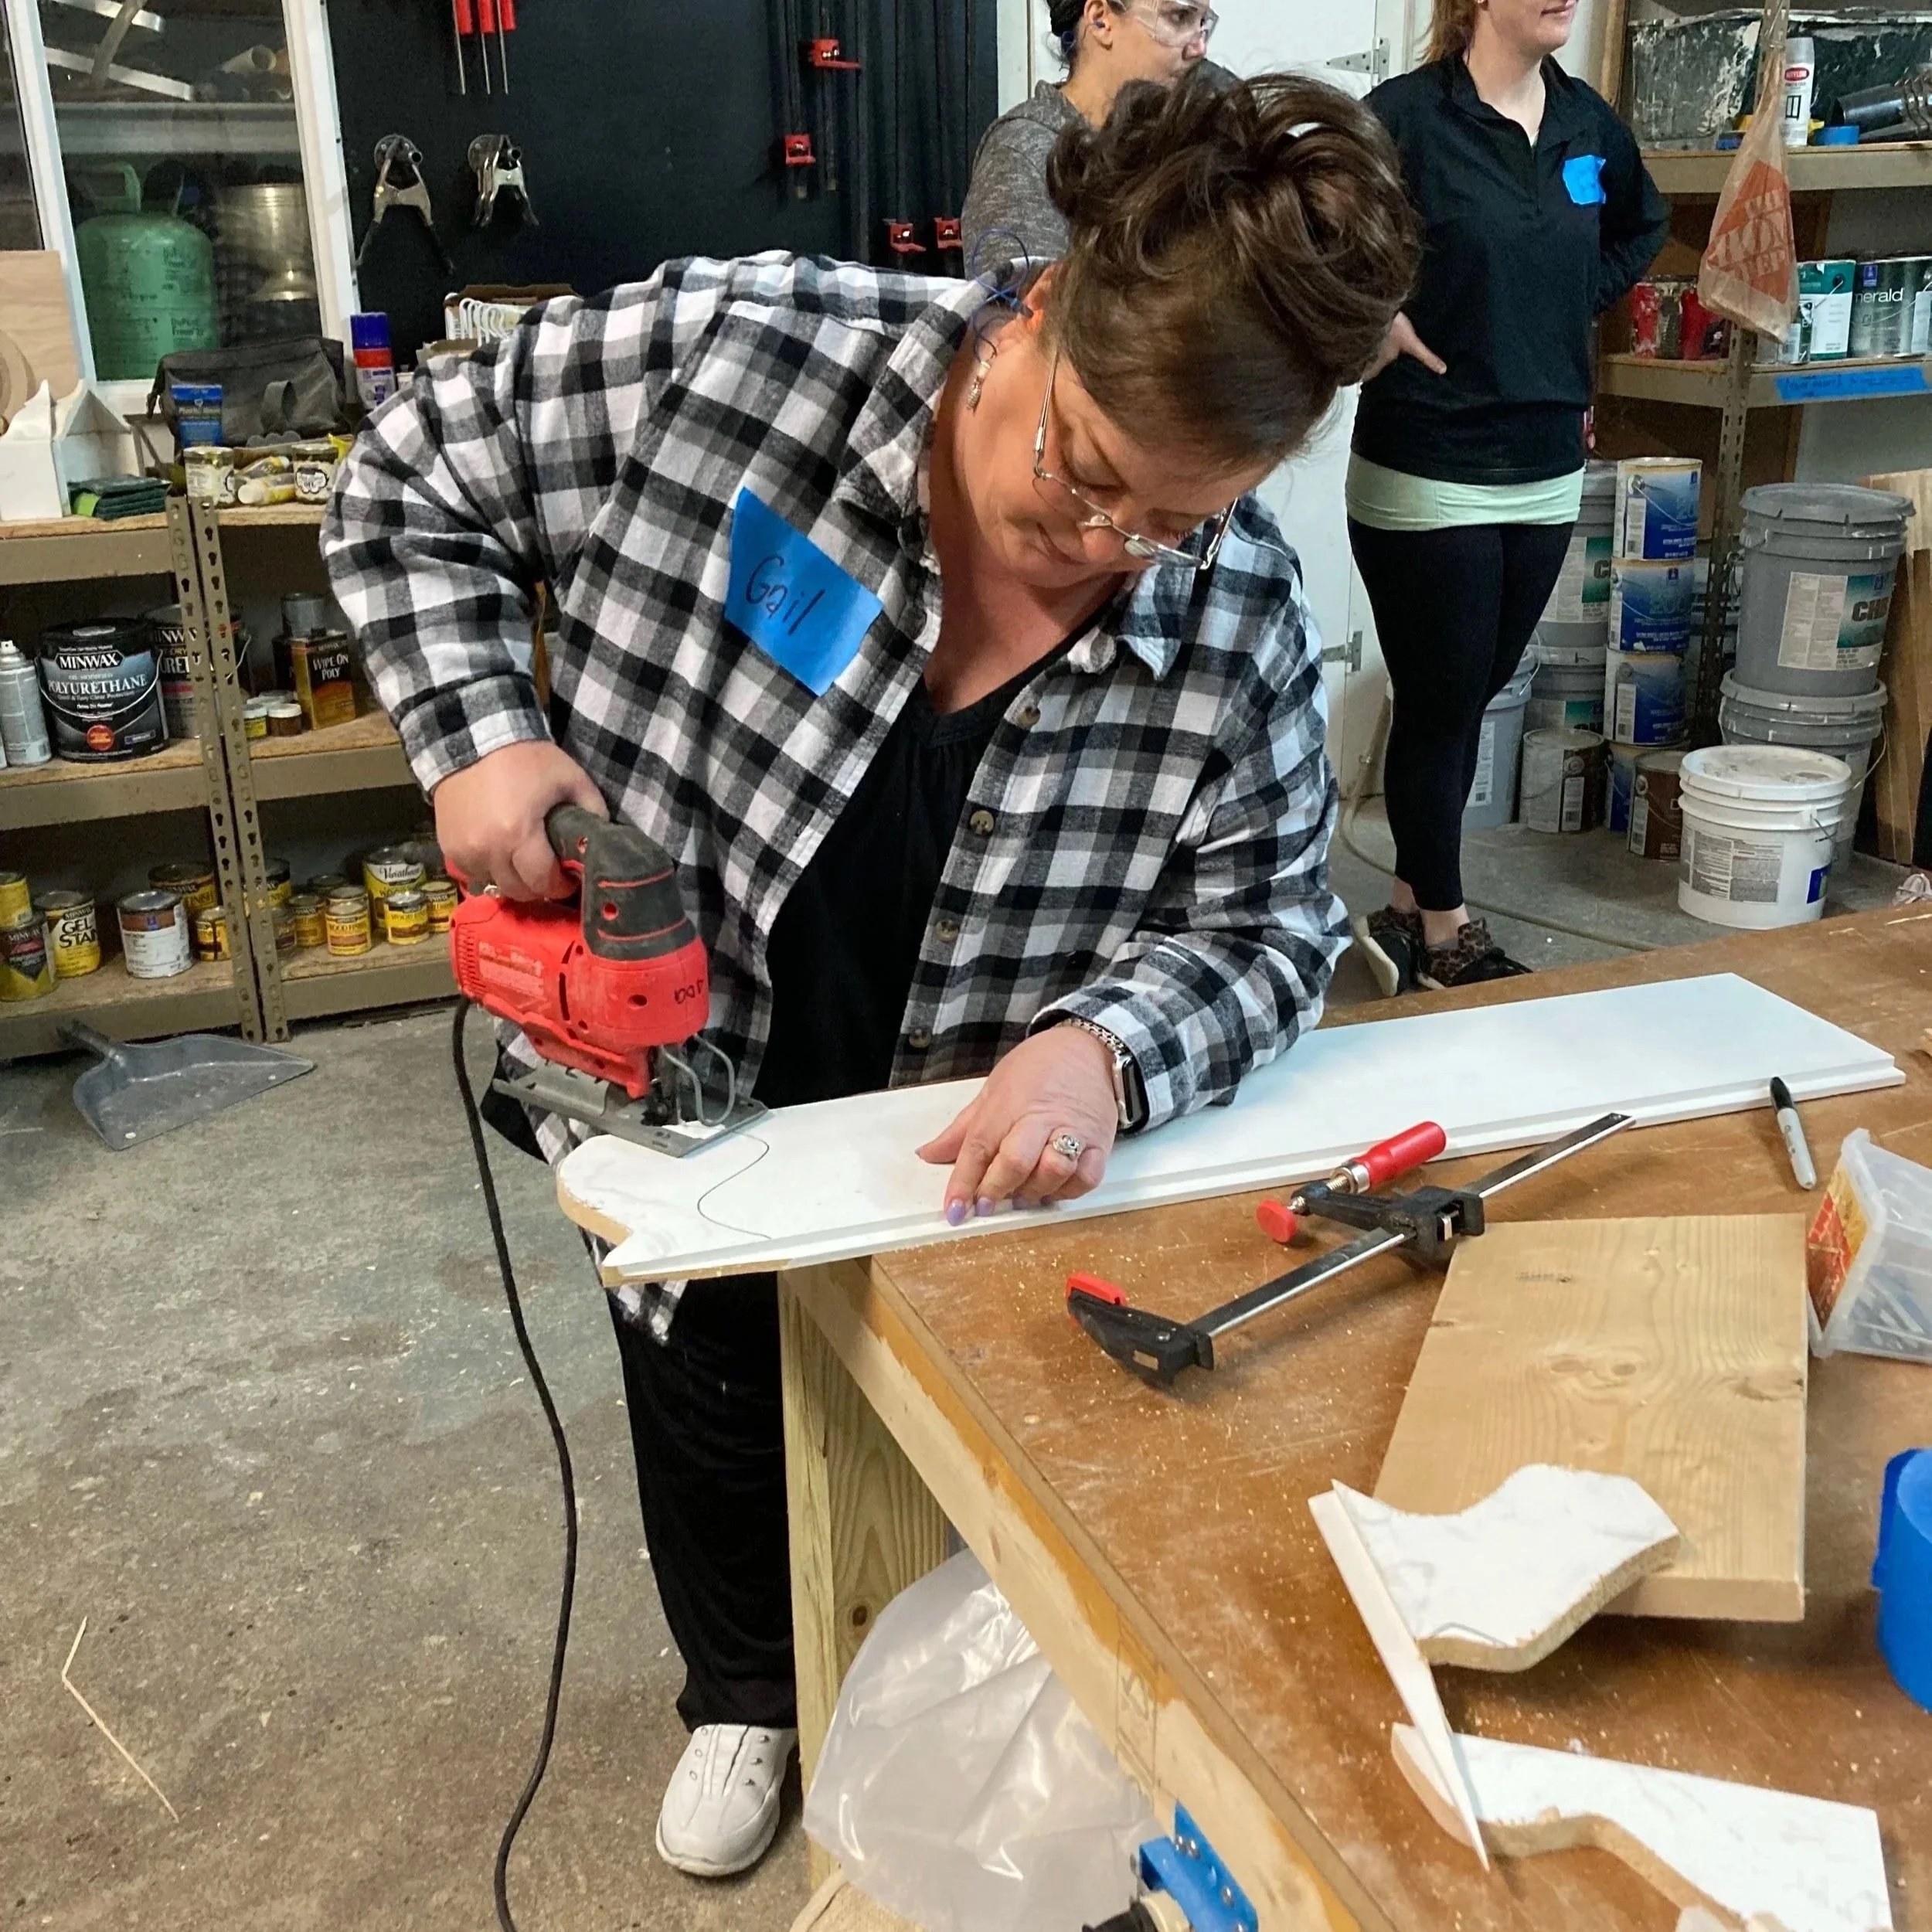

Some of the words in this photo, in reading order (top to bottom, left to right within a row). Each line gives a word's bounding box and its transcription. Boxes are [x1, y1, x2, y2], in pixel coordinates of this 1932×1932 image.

[745, 554, 826, 636] Gail
[59, 653, 117, 669] MINWAX
[312, 657, 335, 671] WIPE
[336, 653, 349, 665] ON
[321, 667, 341, 680] POLY
[48, 673, 147, 695] POLYURETHANE
[62, 917, 94, 934] GEL
